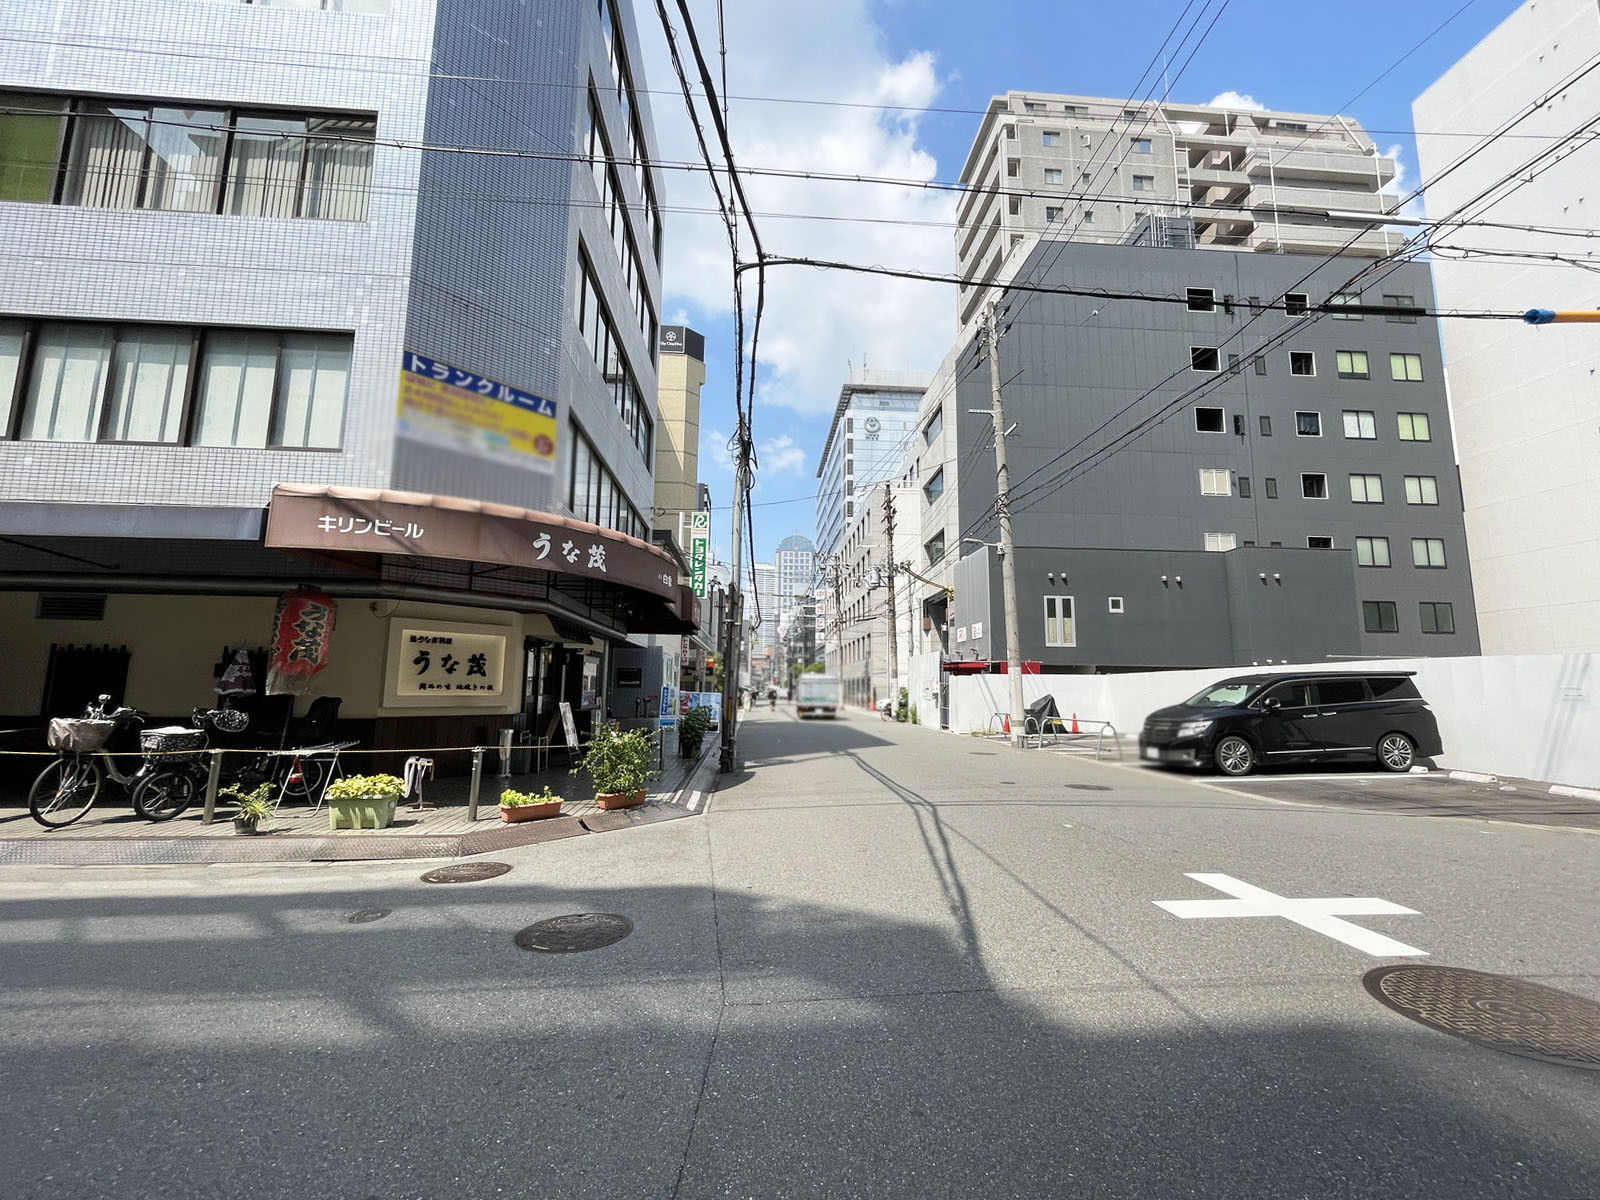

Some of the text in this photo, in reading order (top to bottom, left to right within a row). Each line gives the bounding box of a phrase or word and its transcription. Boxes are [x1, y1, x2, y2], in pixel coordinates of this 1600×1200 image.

[411, 354, 552, 416] トランクルーム
[317, 515, 424, 539] キリンビール
[532, 532, 607, 573] うな茂
[695, 539, 704, 596] トヨタレンタカー
[288, 601, 329, 665] うな茂
[413, 650, 487, 677] うな茂
